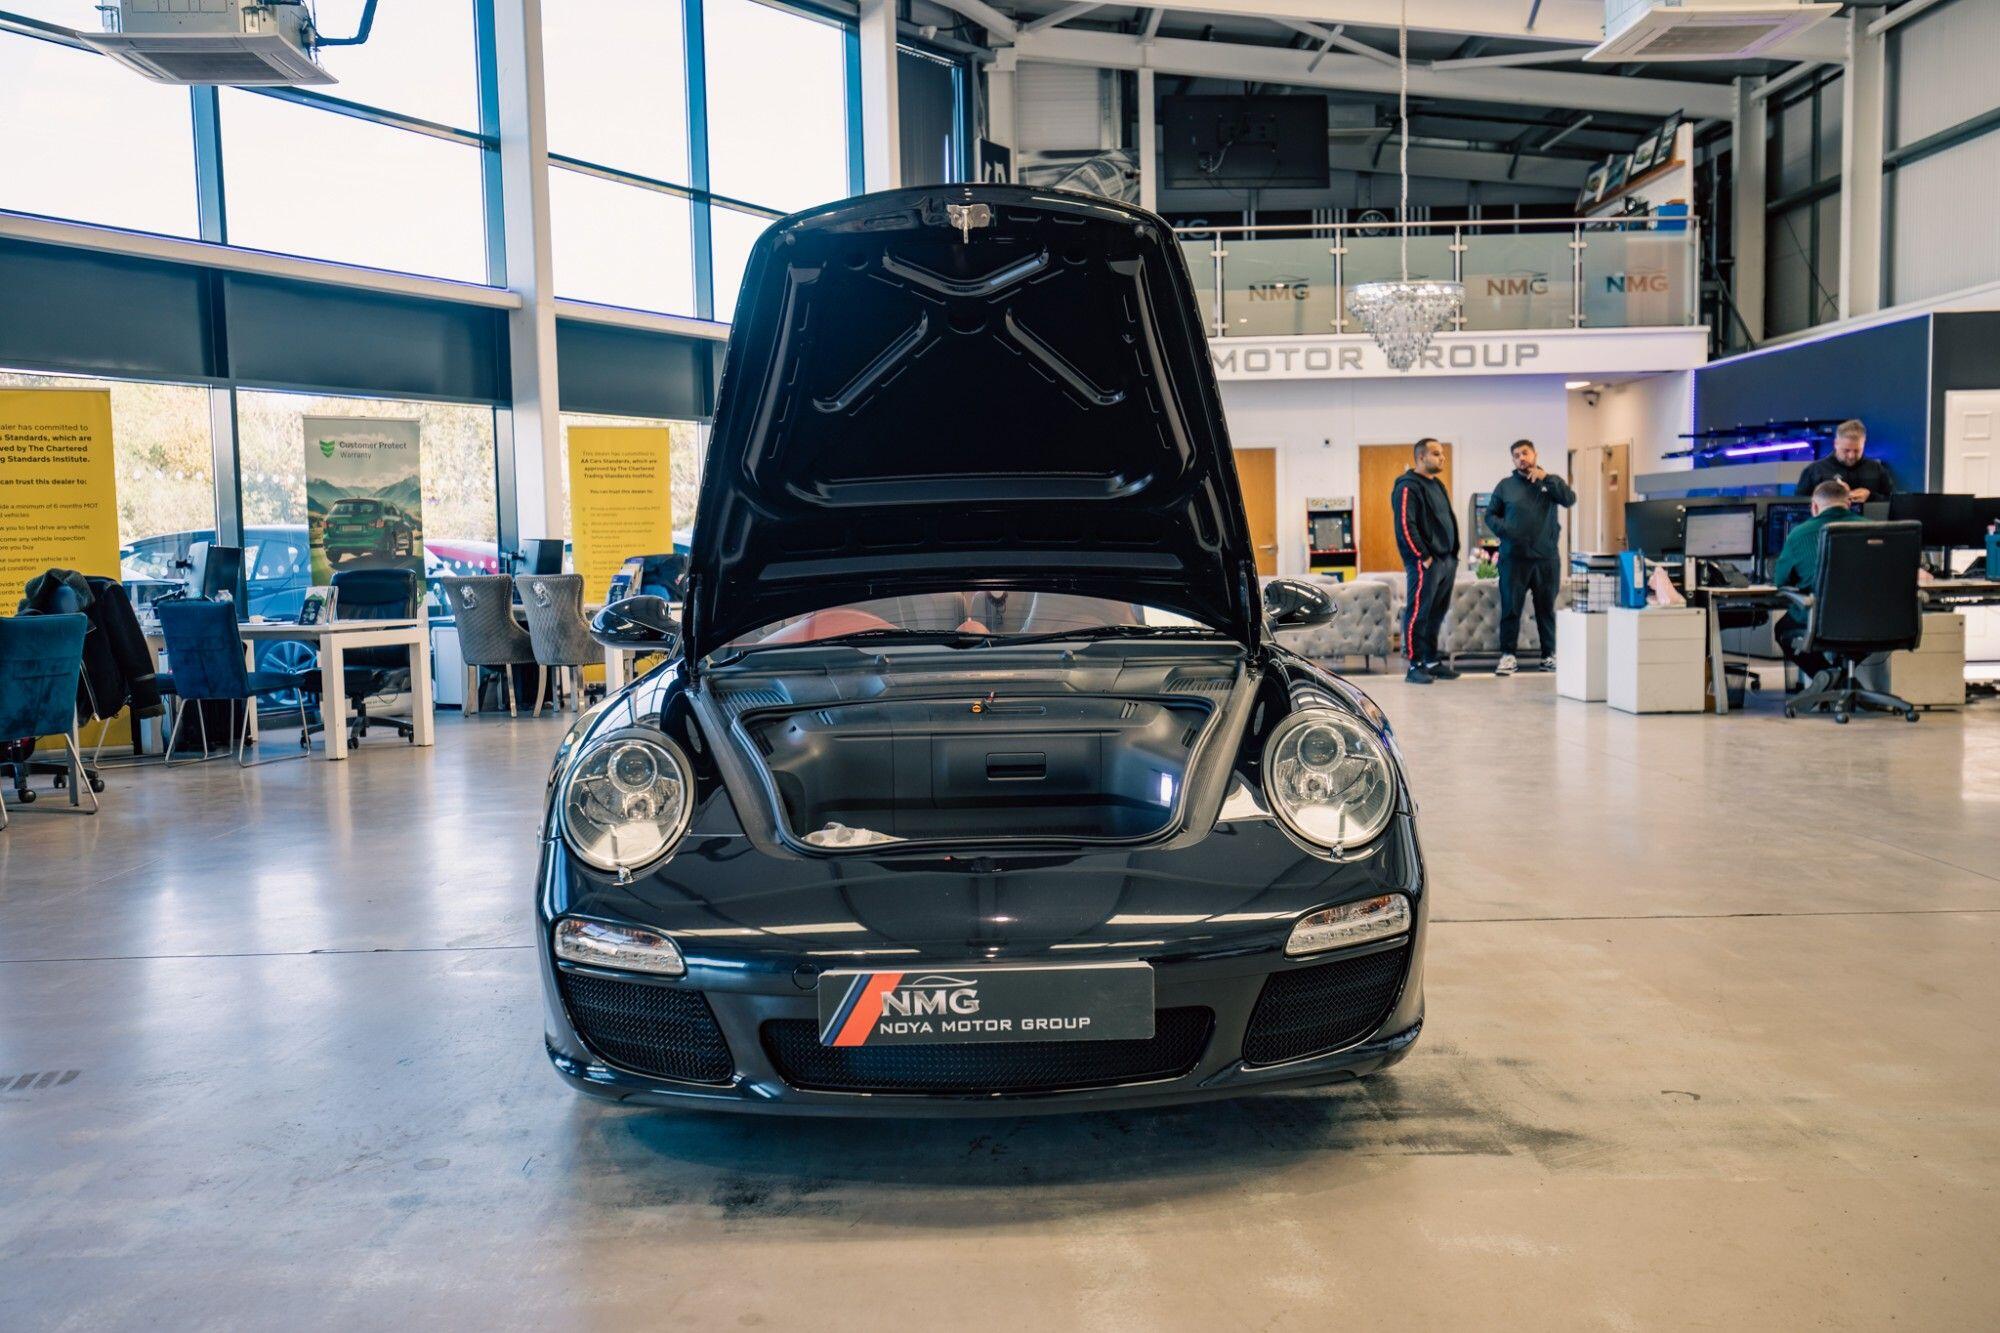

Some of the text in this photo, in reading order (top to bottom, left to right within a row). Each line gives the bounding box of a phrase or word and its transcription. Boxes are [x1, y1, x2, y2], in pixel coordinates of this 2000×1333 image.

[1248, 283, 1310, 302] NMG
[1487, 277, 1549, 296] NMG
[1606, 275, 1669, 293] NMG
[1212, 346, 1363, 372] MOTOR
[0, 423, 16, 431] aler
[18, 423, 32, 431] has
[34, 423, 78, 431] committed
[4, 434, 50, 442] Standards,
[339, 441, 407, 449] Customer Protect
[16, 445, 26, 453] by
[28, 444, 44, 452] The
[7, 455, 50, 463] Standards
[52, 455, 90, 463] Institute.
[880, 988, 980, 1017] NMG
[880, 1017, 1091, 1034] NOYA MOTOR GROUP
